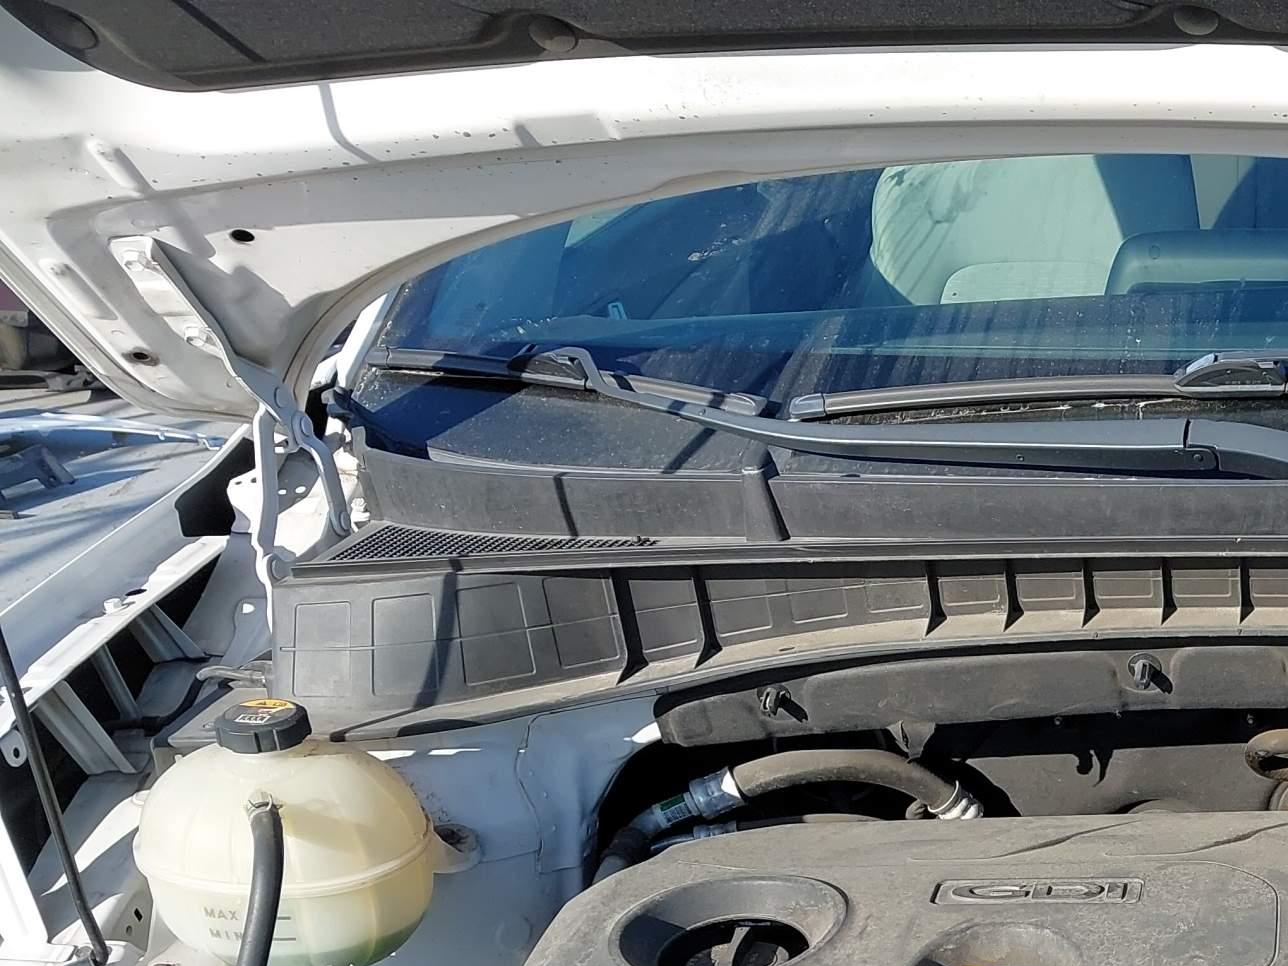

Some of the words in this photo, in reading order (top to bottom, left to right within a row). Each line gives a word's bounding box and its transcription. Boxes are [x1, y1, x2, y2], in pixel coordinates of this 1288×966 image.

[952, 882, 1127, 901] GDI
[204, 907, 238, 920] MAX
[209, 928, 243, 941] MIN
